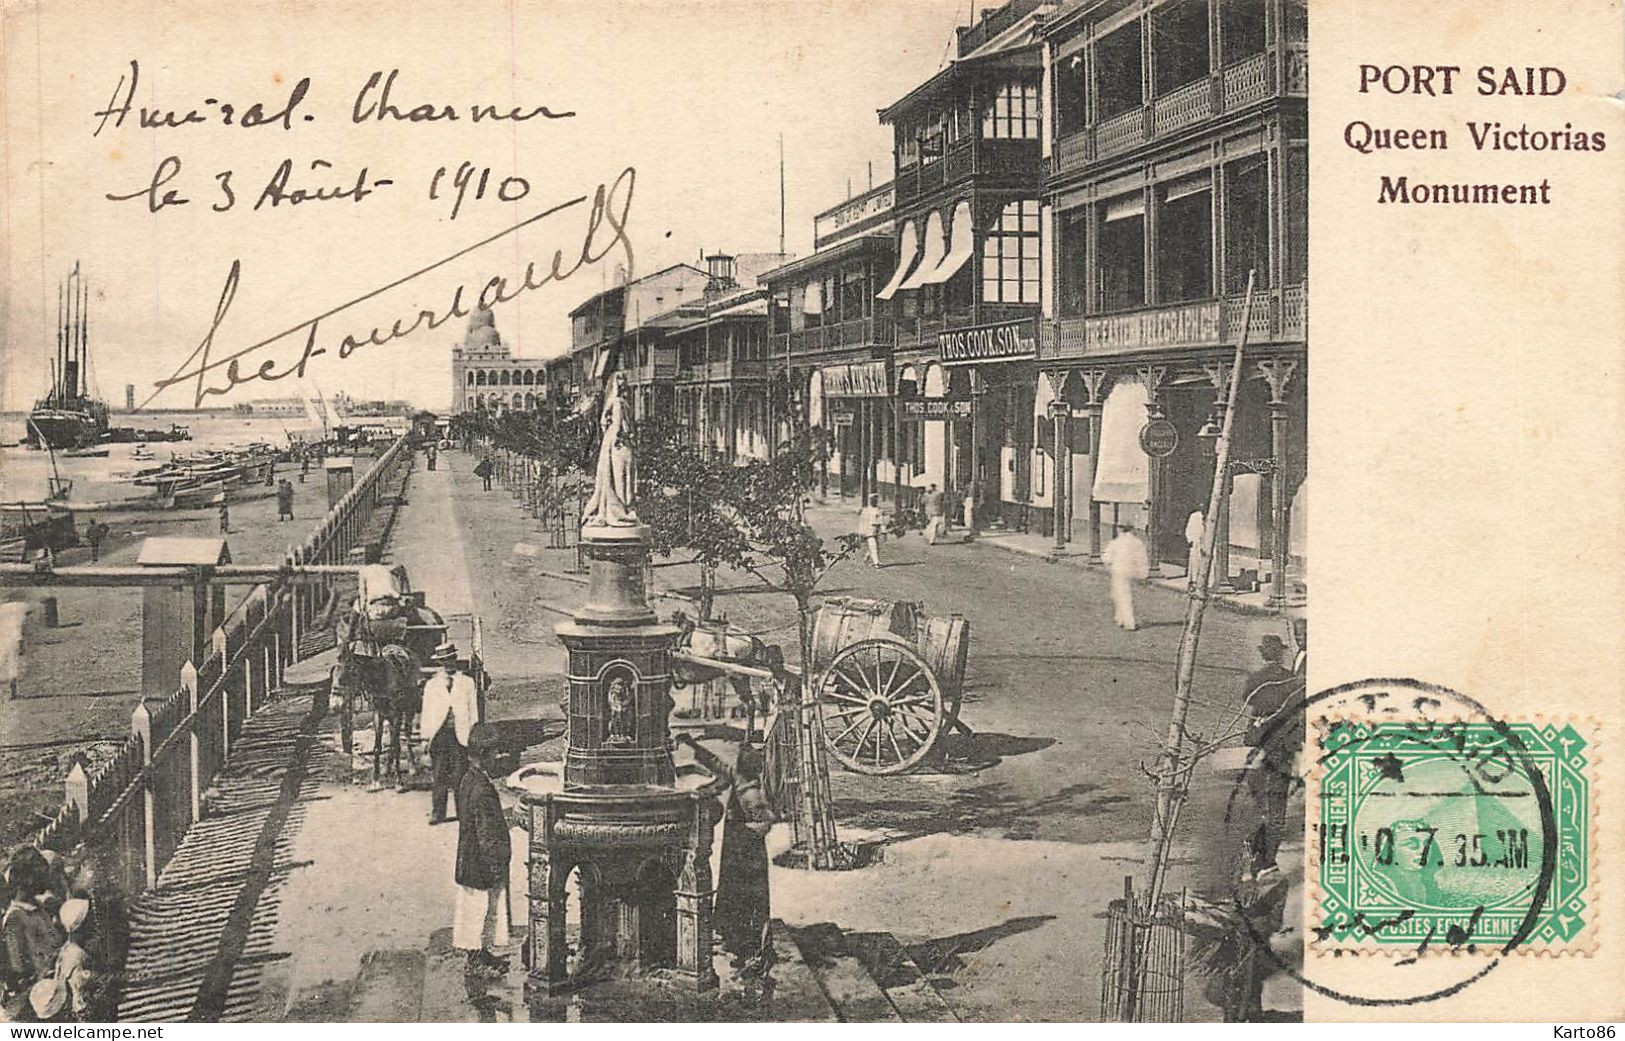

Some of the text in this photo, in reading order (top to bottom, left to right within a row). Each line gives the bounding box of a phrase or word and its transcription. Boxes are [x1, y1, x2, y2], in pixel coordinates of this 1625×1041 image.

[1358, 64, 1567, 97] PORT SAID
[1344, 120, 1607, 154] Queen Victorias
[213, 171, 236, 212] 3
[428, 158, 531, 220] 1910
[1377, 175, 1552, 204] Monument
[967, 328, 996, 357] COOK
[998, 325, 1020, 355] SON
[1141, 309, 1200, 346] TELEGRAPH
[927, 402, 949, 414] COOK
[955, 401, 971, 413] SON
[1381, 916, 1525, 935] POSTES EGYPIENNE
